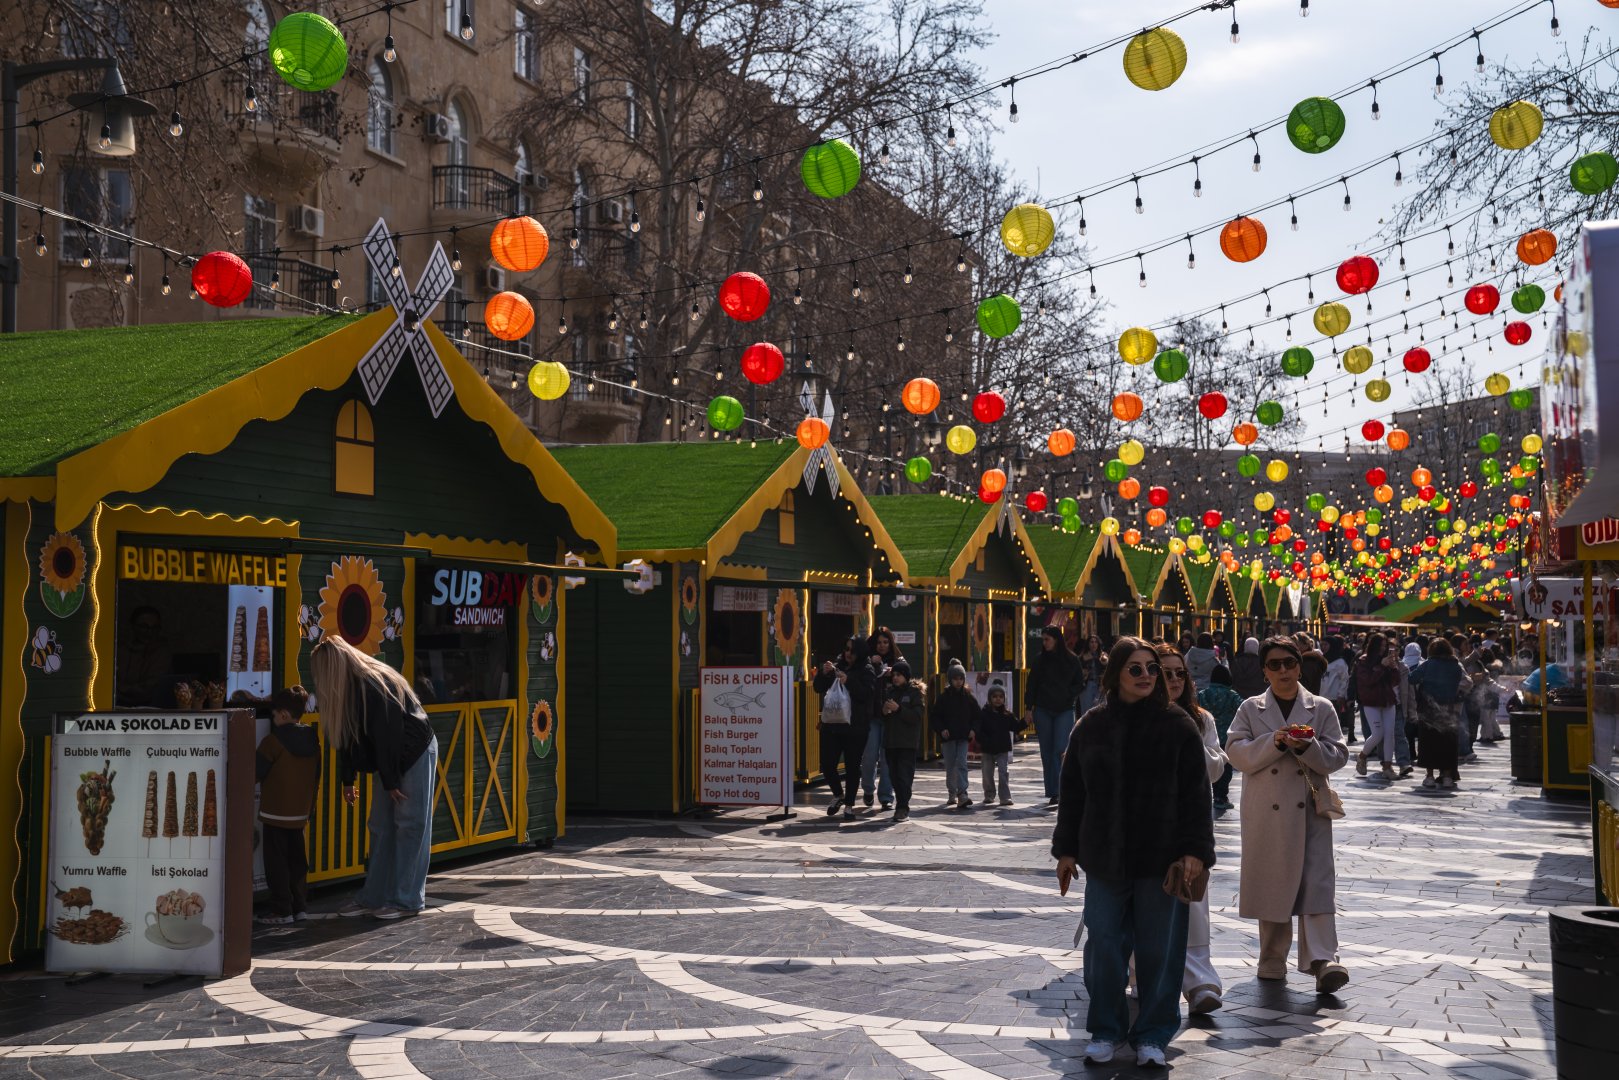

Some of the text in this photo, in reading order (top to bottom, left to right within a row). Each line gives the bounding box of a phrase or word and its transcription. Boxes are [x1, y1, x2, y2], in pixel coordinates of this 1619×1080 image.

[123, 546, 287, 587] BUBBLE WAFFLE
[431, 569, 528, 608] SUBDAY
[454, 607, 504, 625] SANDWICH
[732, 674, 740, 684] &
[76, 719, 116, 732] YANA
[120, 718, 191, 733] ŞOKOLAD
[704, 715, 763, 725] Balıq Bükmə
[704, 730, 758, 741] Fish Burger
[64, 747, 131, 757] Bubble Waffle
[146, 747, 220, 759] Çubuqlu Waffle
[704, 745, 762, 755] Balıq Topları
[704, 760, 777, 770] Kalmar Halqaları
[704, 774, 777, 784] Krevet Tempura
[704, 788, 760, 799] Top Hot dog
[62, 865, 127, 876] Yumru Waffle
[151, 864, 208, 878] İsti Şokolad
